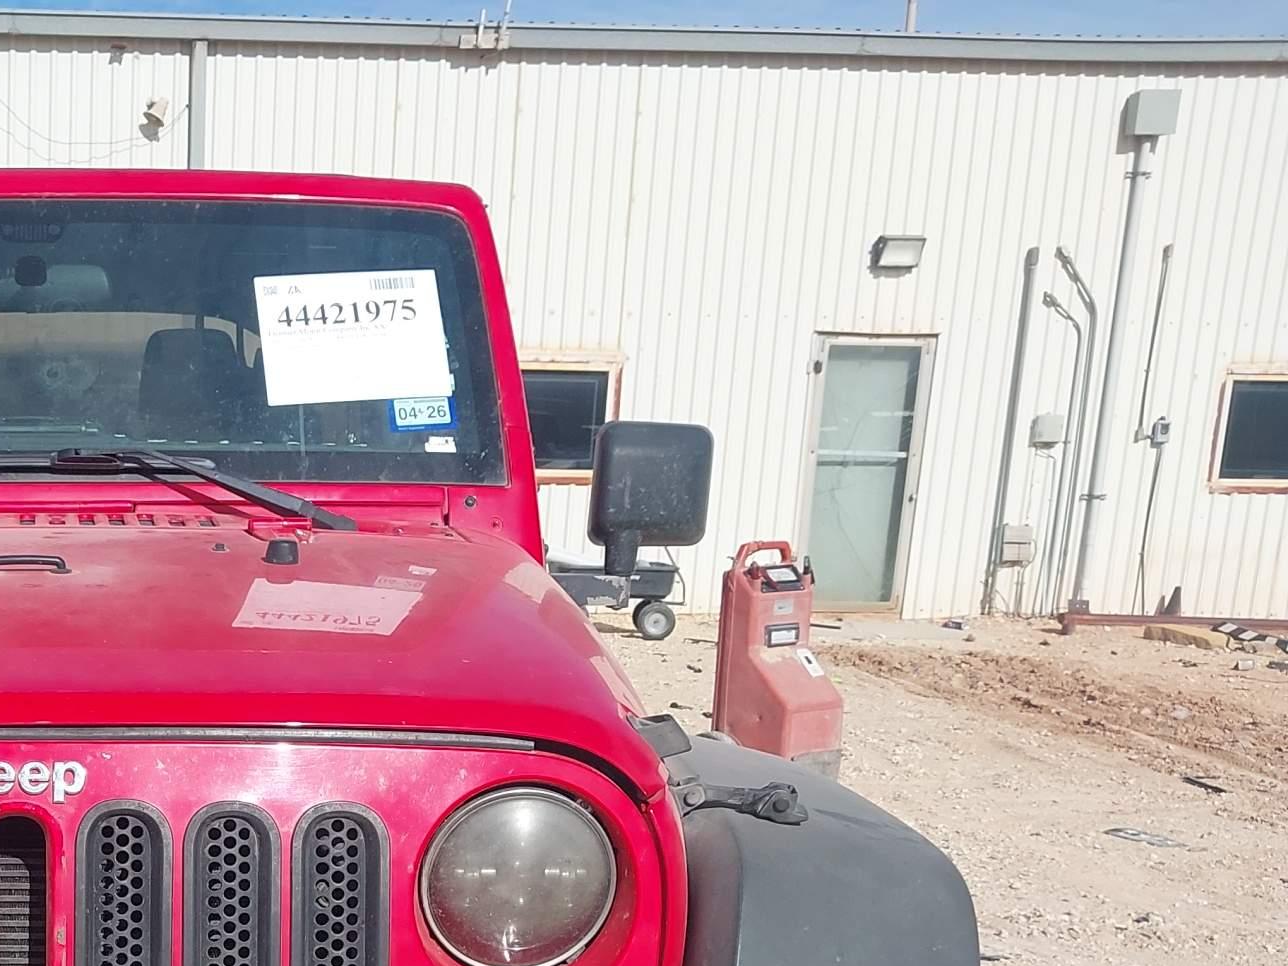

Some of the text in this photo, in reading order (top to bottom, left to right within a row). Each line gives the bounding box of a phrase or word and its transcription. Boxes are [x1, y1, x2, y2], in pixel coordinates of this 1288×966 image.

[278, 298, 417, 328] 44421975
[398, 404, 447, 421] 04 26
